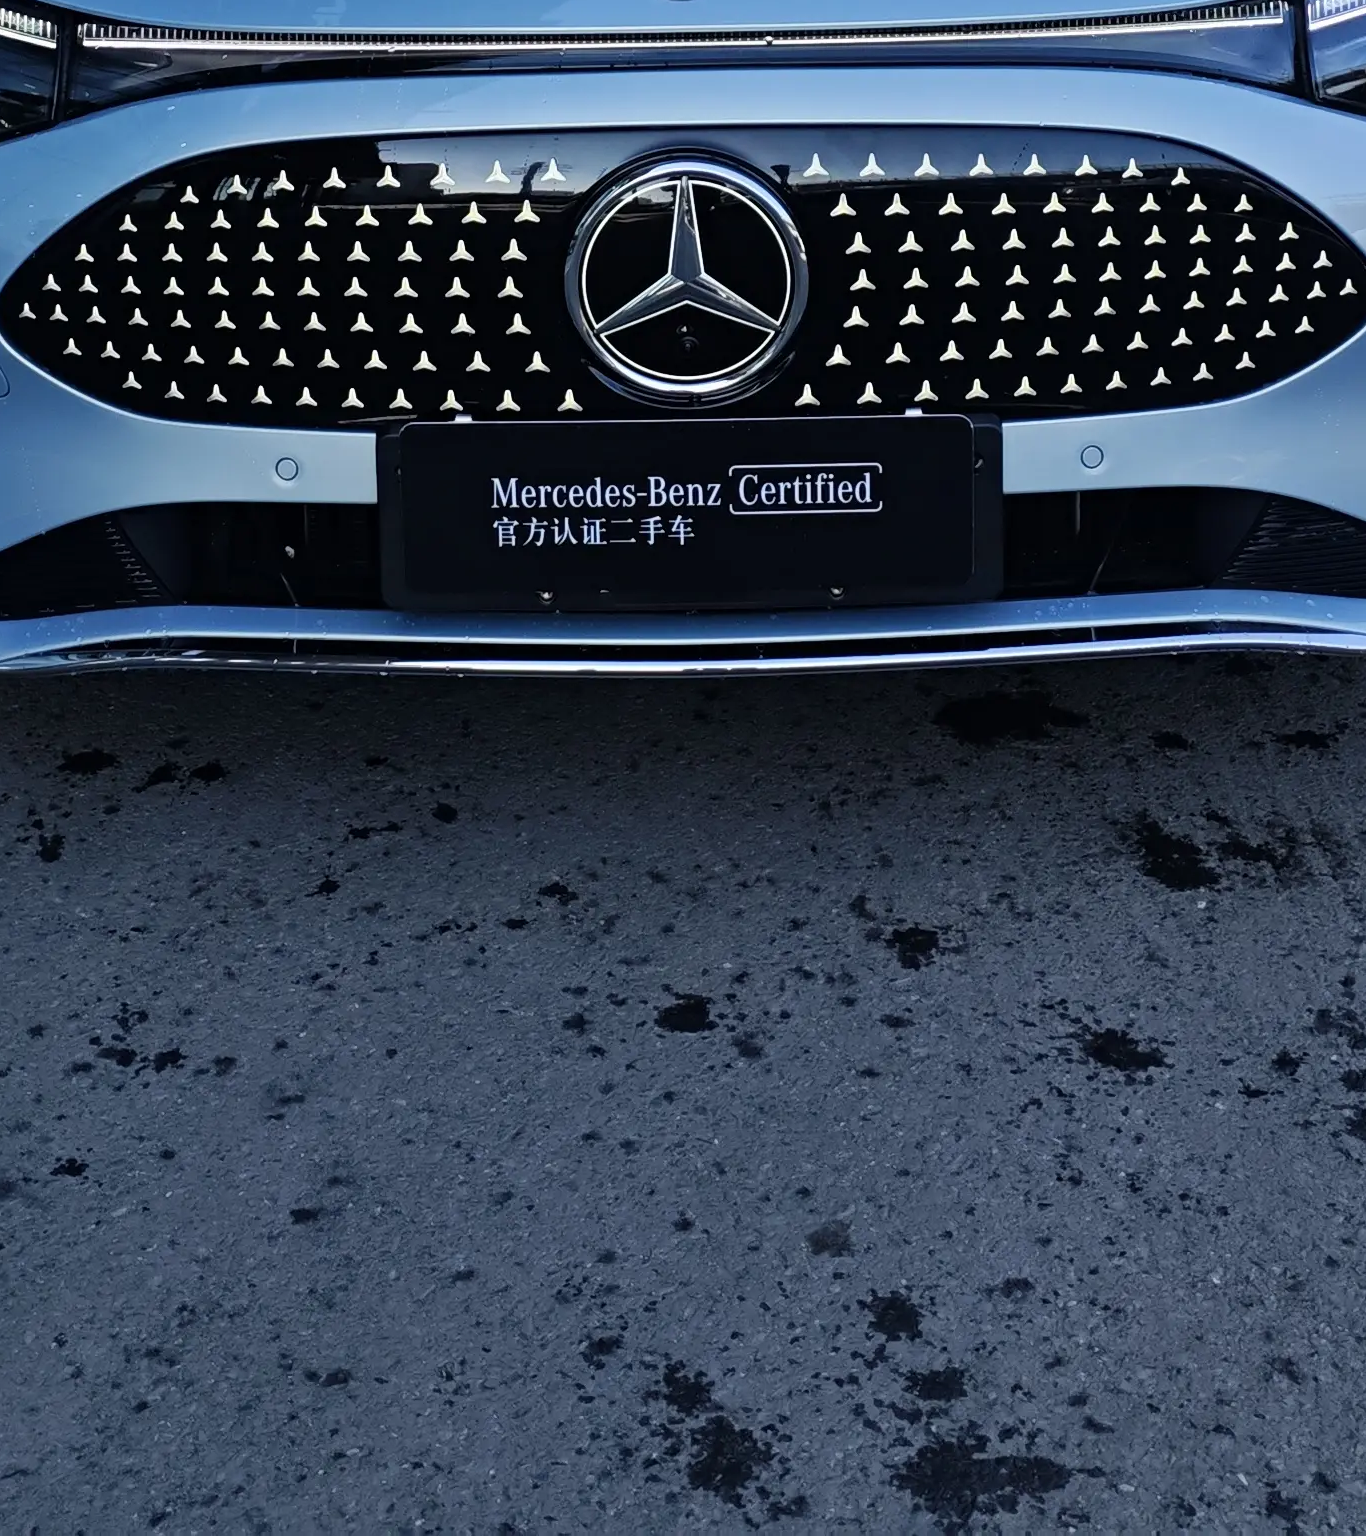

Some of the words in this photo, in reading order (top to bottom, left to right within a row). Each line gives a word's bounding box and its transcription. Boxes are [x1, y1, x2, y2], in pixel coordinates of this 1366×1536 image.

[491, 476, 722, 508] Mercedes-Benz
[739, 472, 873, 506] Certified
[493, 515, 695, 547] 官方认证二手车
